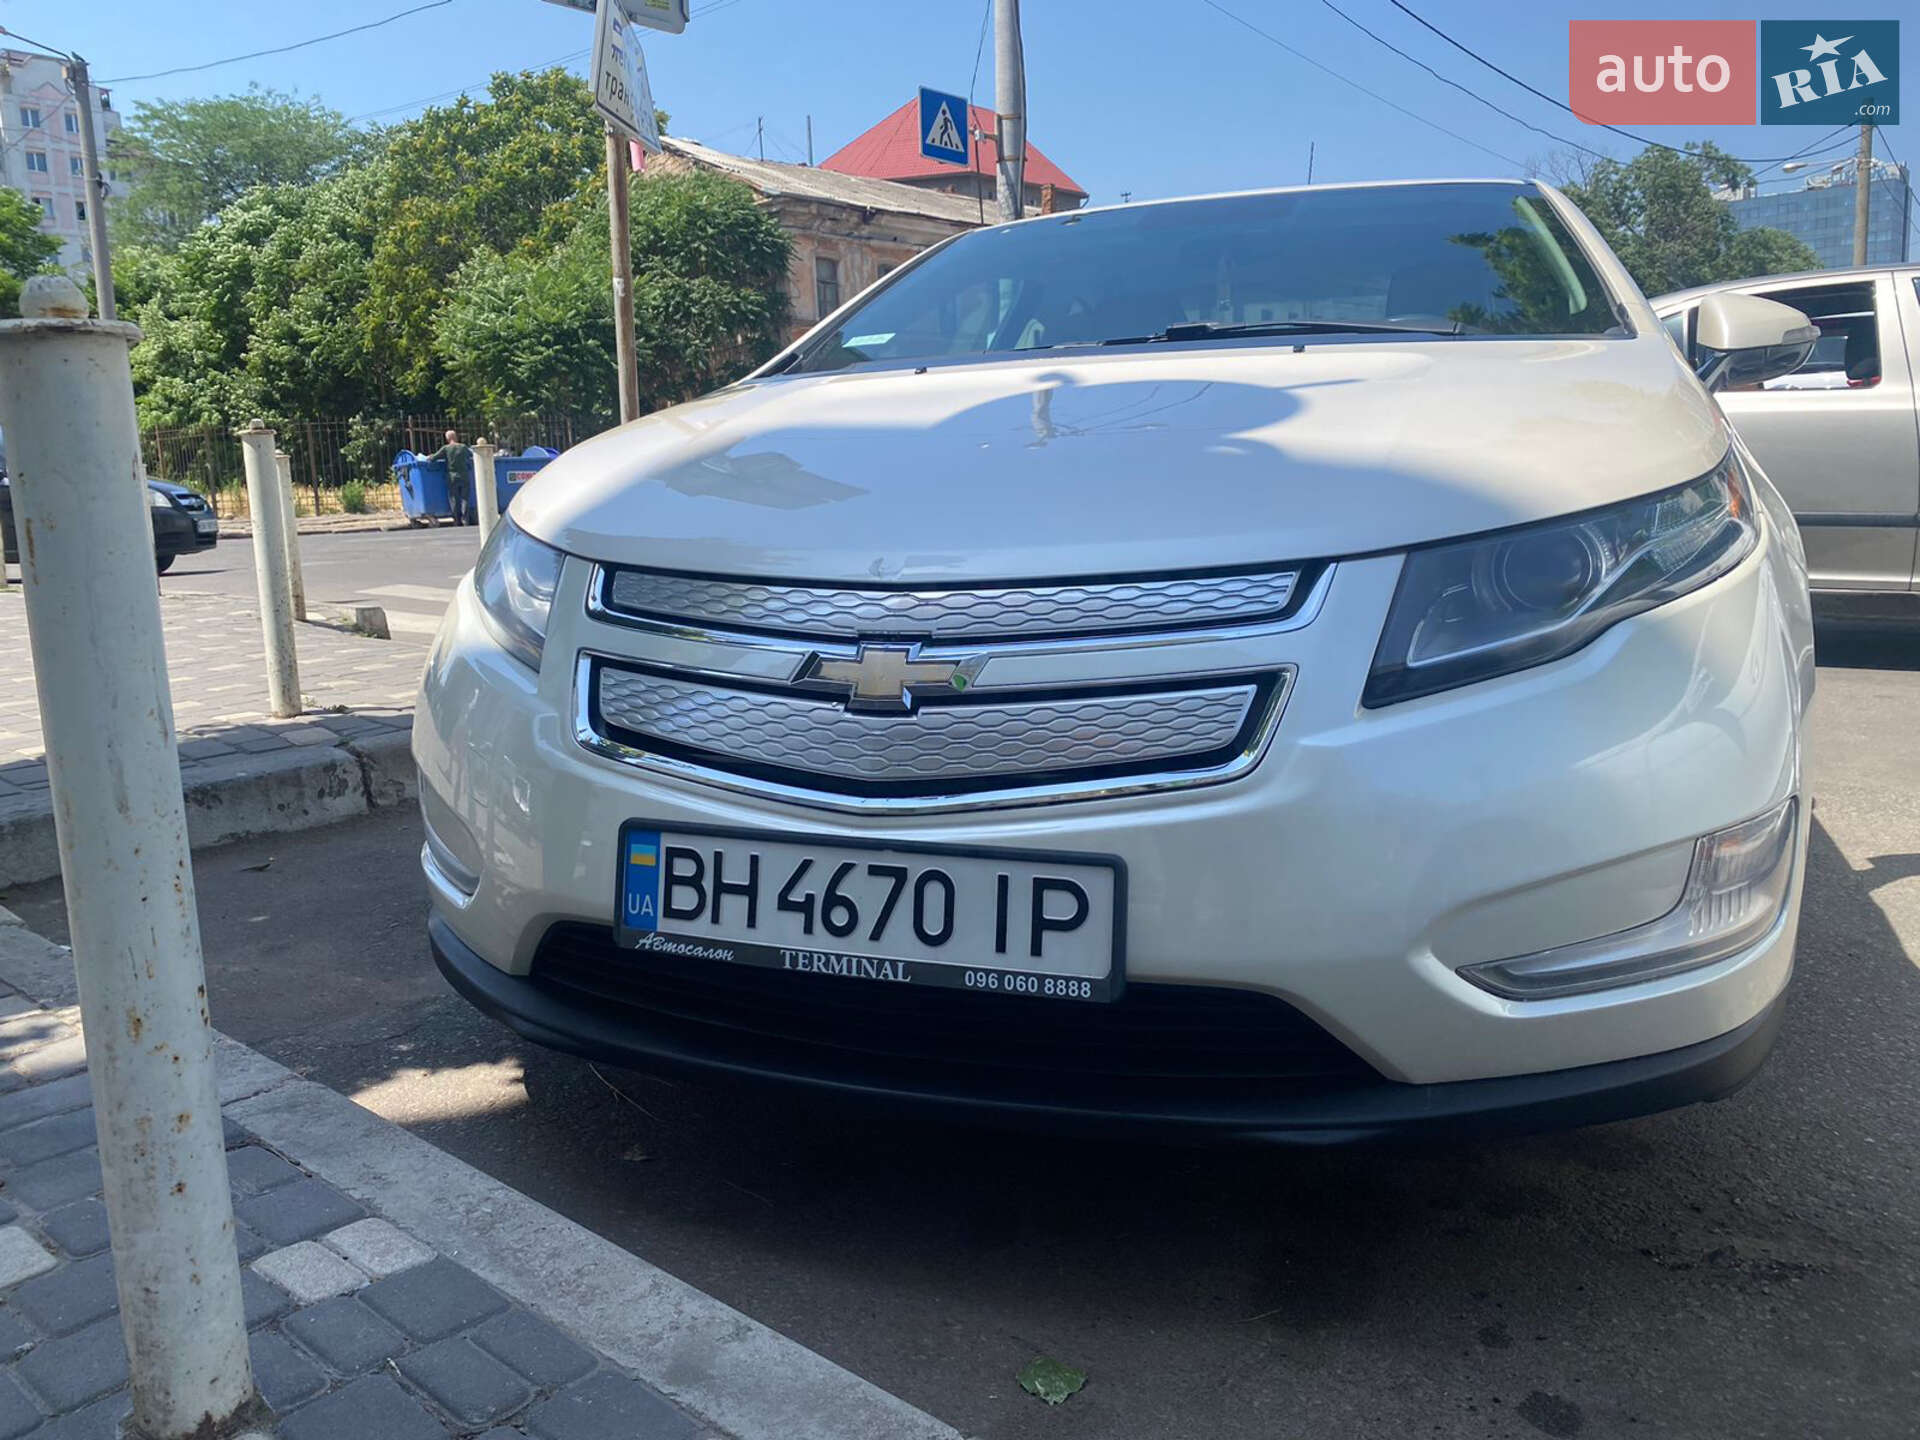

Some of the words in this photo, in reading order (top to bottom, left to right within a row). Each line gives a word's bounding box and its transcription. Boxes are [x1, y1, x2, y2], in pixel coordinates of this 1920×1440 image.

[628, 893, 654, 917] UA
[662, 846, 760, 929] BH
[777, 857, 956, 947] 4670
[995, 873, 1089, 957] IP
[780, 949, 912, 982] TERMINAL
[964, 970, 999, 990] 096
[1003, 974, 1039, 994] 060
[1043, 978, 1092, 998] 8888
